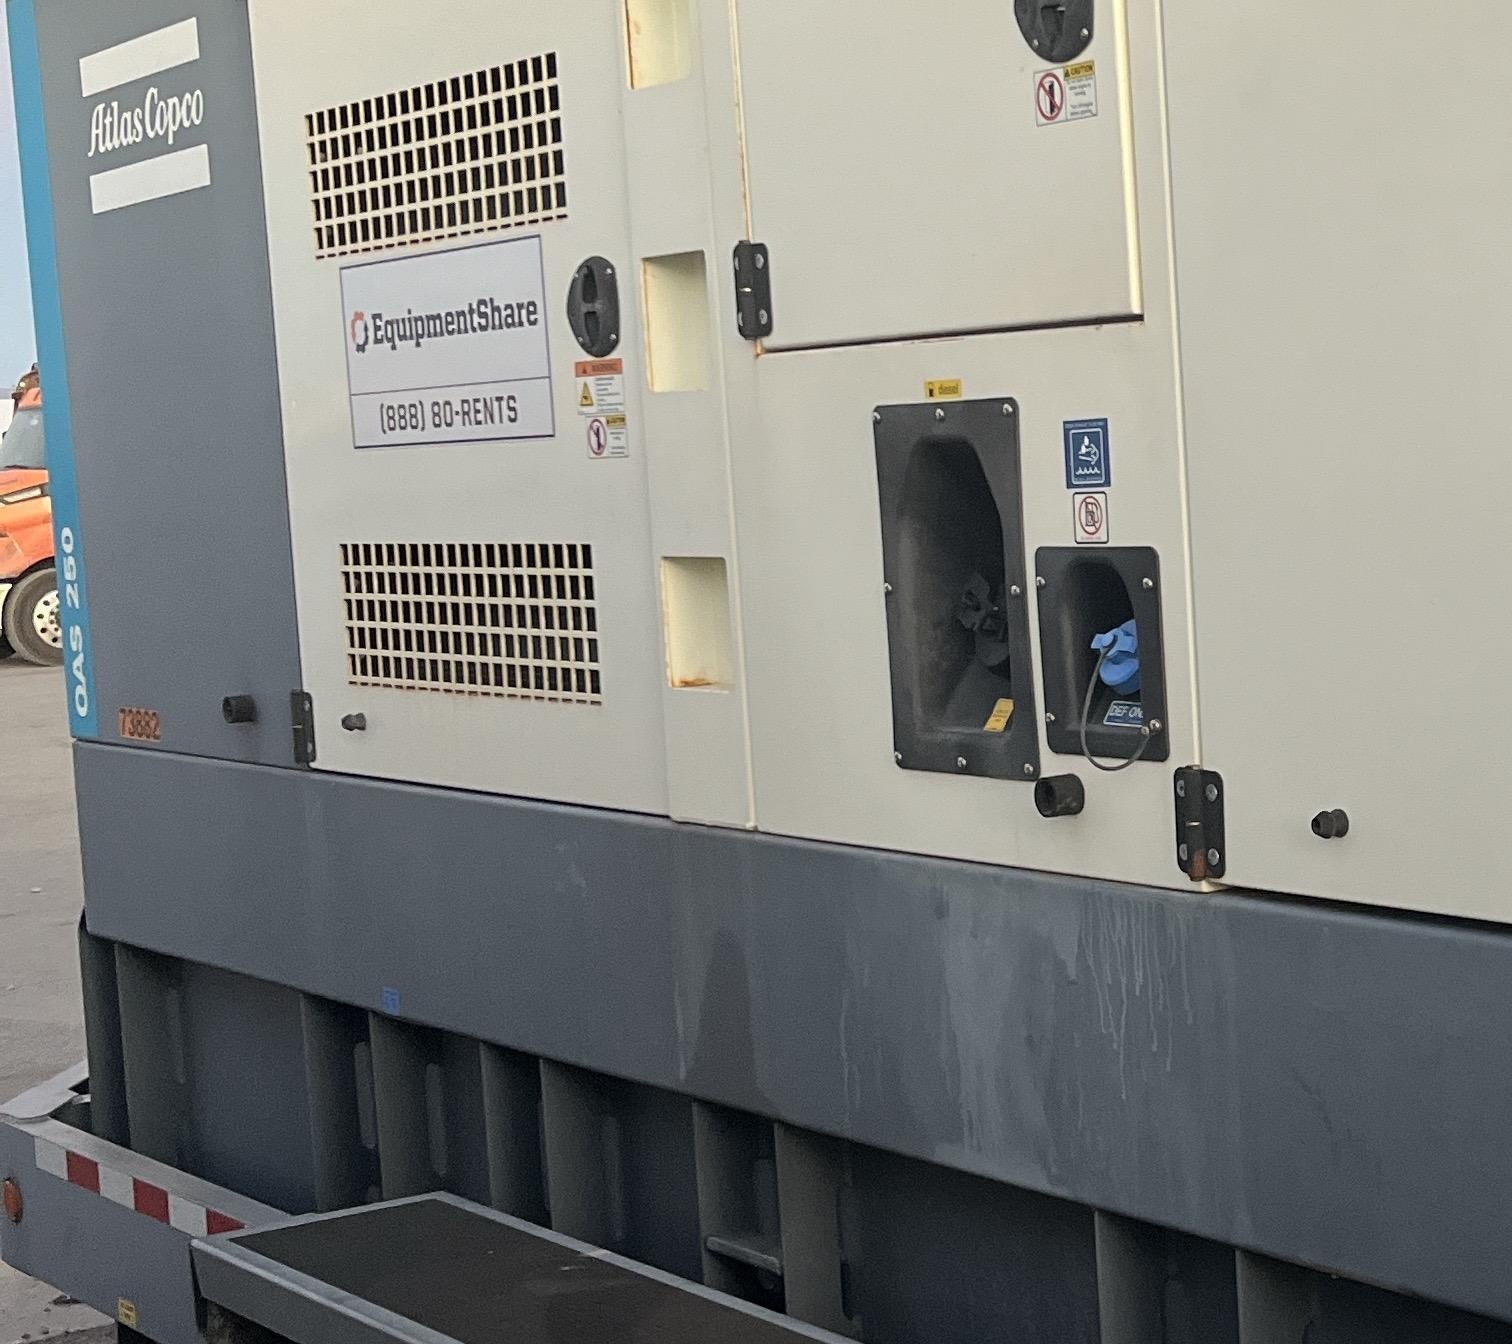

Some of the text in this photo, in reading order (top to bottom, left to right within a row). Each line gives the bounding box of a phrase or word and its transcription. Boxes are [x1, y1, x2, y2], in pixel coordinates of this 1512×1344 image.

[87, 86, 204, 158] Atlas Copco
[371, 296, 539, 351] EquipmentShare
[380, 395, 519, 435] (888) 80-RENTS
[61, 526, 80, 610] 250
[1109, 705, 1129, 717] DEF
